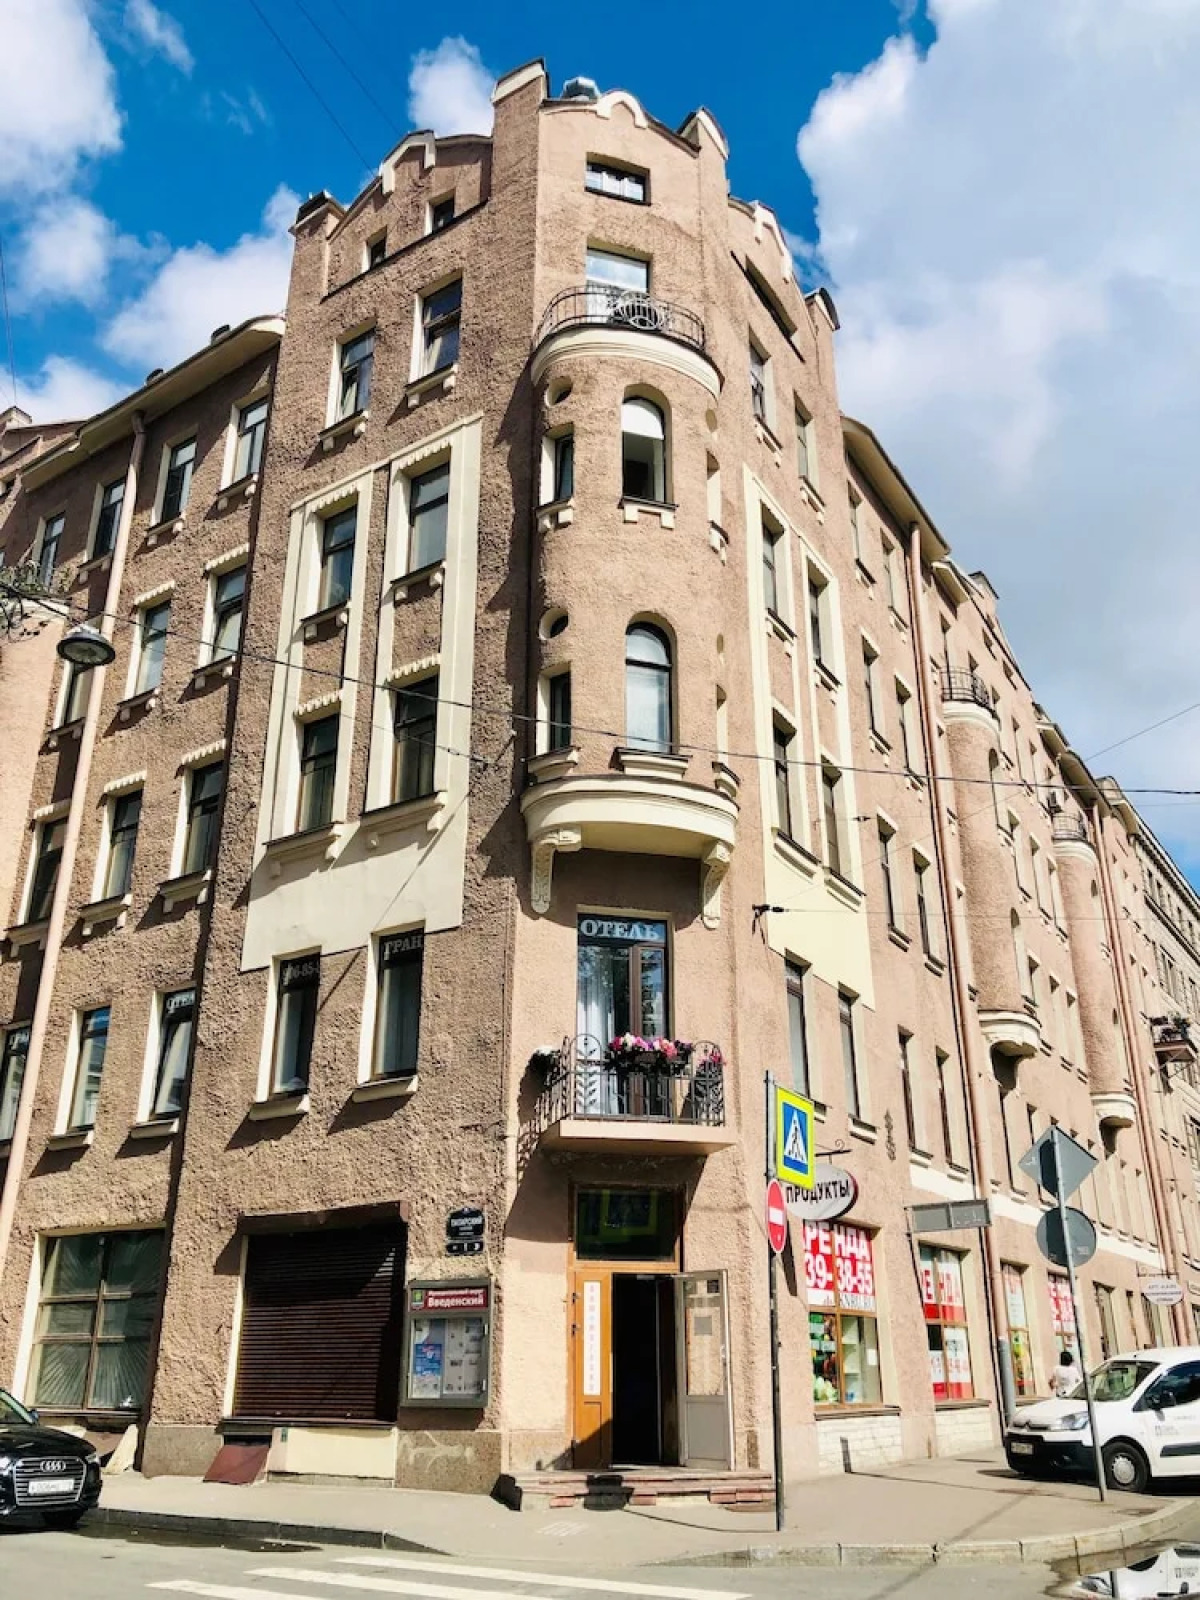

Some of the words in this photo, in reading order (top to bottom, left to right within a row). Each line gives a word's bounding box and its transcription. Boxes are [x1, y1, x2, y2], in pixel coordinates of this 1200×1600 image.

[580, 919, 659, 940] ОТЕЛЬ
[786, 1179, 850, 1205] ПРОДУКТЫ
[428, 1296, 484, 1308] Введенский
